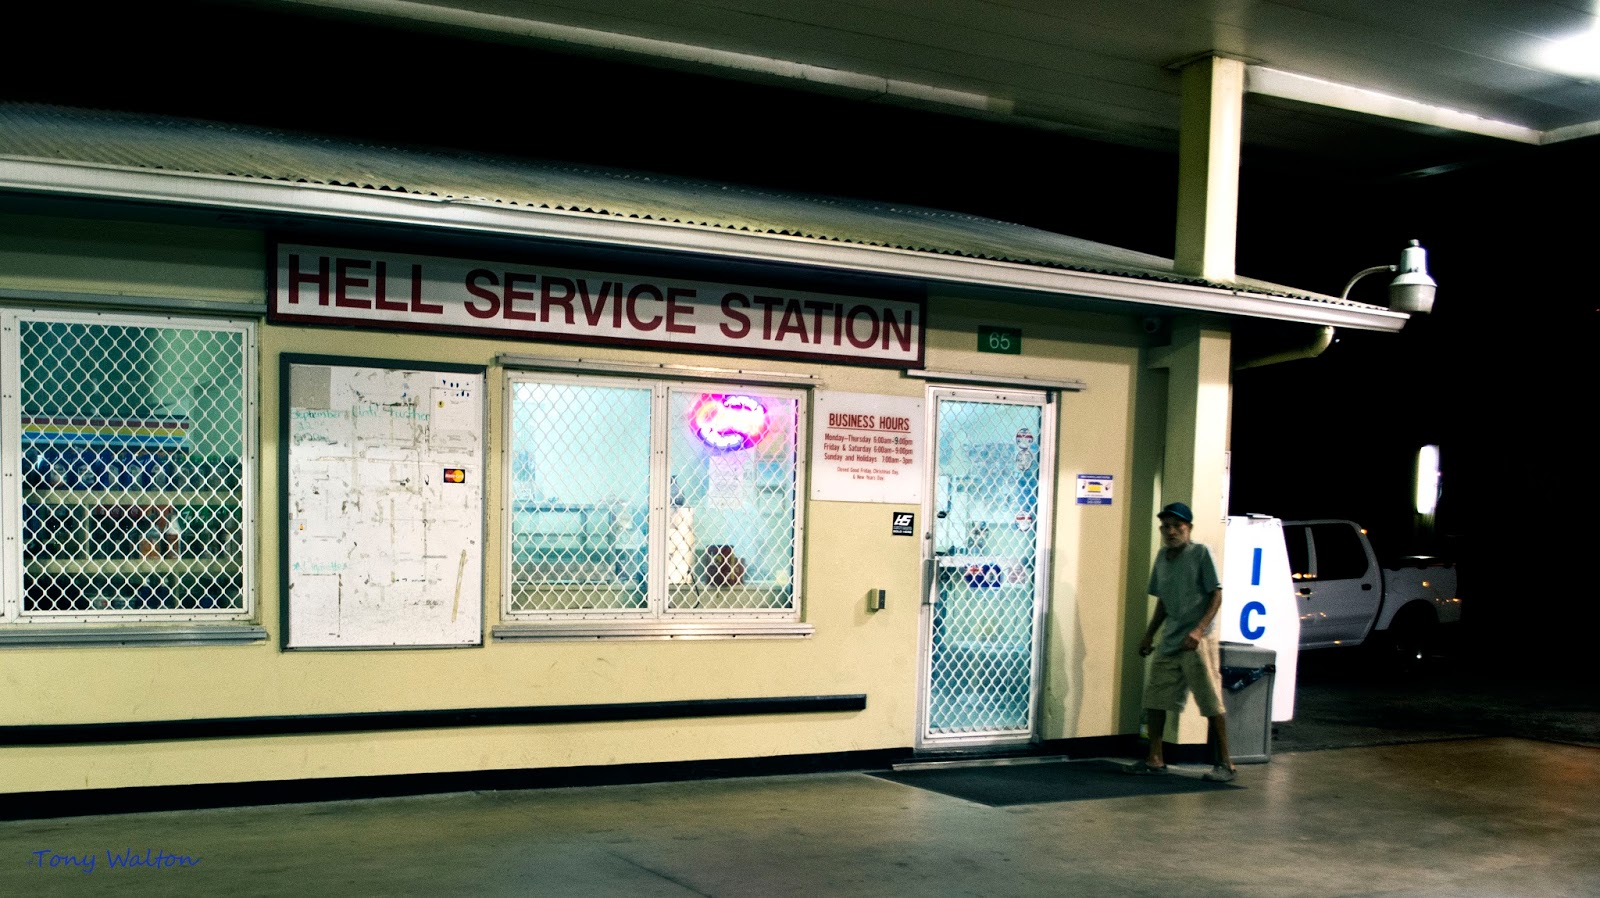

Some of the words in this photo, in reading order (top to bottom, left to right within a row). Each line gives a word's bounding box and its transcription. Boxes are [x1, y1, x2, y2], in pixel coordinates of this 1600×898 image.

[288, 253, 443, 314] HELL
[463, 268, 697, 334] SERVICE
[719, 291, 912, 353] STATION
[989, 331, 1011, 350] 65
[829, 413, 875, 429] BUSINESS
[879, 417, 910, 431] HOURS
[823, 443, 840, 452] Friday
[848, 444, 872, 454] Saturday
[824, 453, 843, 462] Sunday
[856, 455, 877, 463] Holidays
